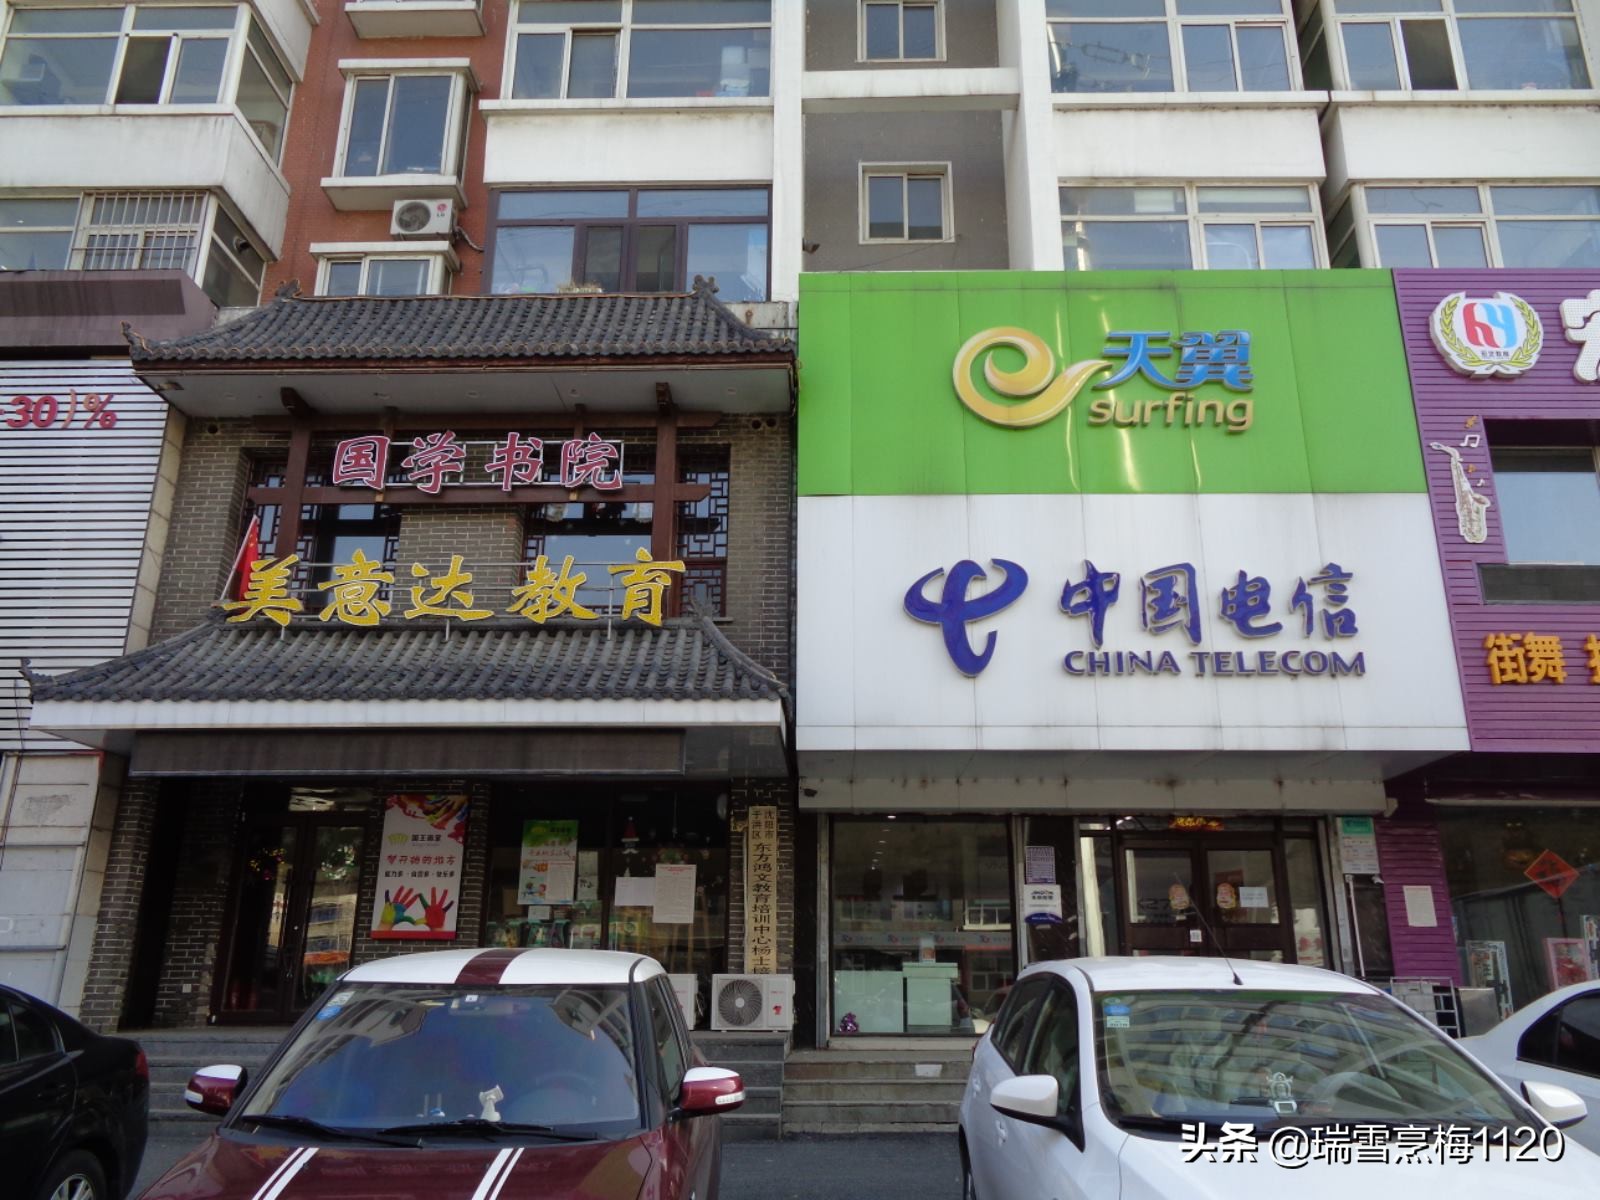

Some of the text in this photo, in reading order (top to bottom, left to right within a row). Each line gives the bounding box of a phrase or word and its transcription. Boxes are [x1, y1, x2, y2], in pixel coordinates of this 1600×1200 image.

[1091, 330, 1253, 391] 天翼
[1088, 392, 1253, 433] surfing
[332, 430, 624, 495] 国学书院
[224, 547, 686, 627] 美意达教育
[1060, 559, 1359, 649] 中国电信
[1063, 650, 1367, 677] CHINA TELECOM
[1484, 631, 1568, 686] 街舞
